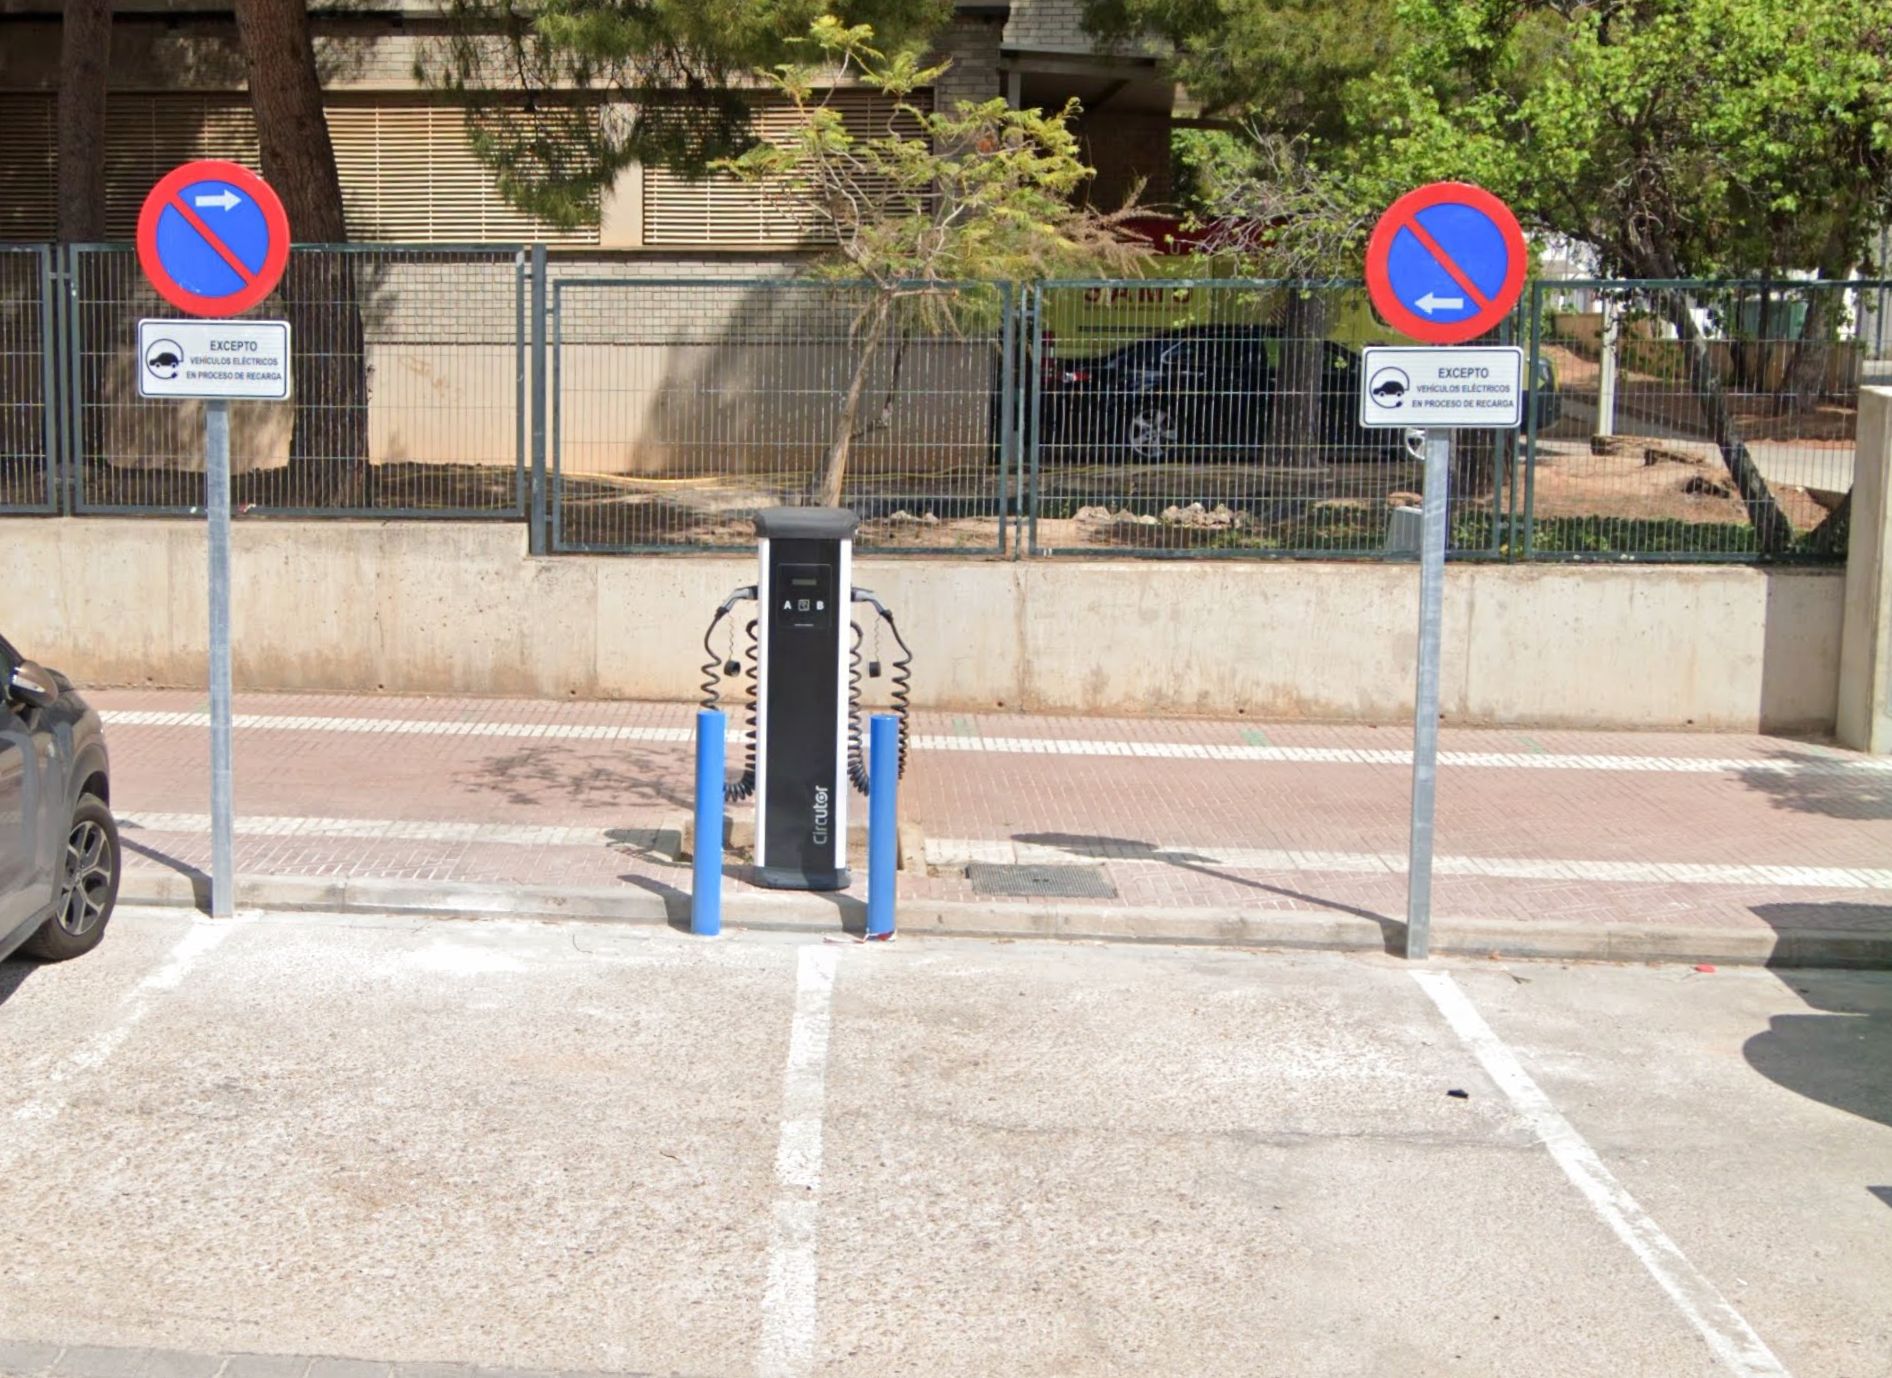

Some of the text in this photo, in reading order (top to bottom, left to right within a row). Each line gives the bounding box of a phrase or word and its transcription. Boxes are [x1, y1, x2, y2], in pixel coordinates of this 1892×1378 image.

[210, 340, 258, 352] EXCEPTO
[190, 356, 279, 366] VEHÍCULOS ELÉCTRICOS
[186, 371, 282, 381] EN PROCESO DE RECARGA
[1438, 367, 1489, 379] EXCEPTO
[1416, 383, 1511, 393] VEHÍCULOS ELÉCTRICOS
[1412, 399, 1514, 409] EN PROCESO DE RECARGA
[783, 600, 825, 610] A B
[812, 785, 829, 845] Circutor
